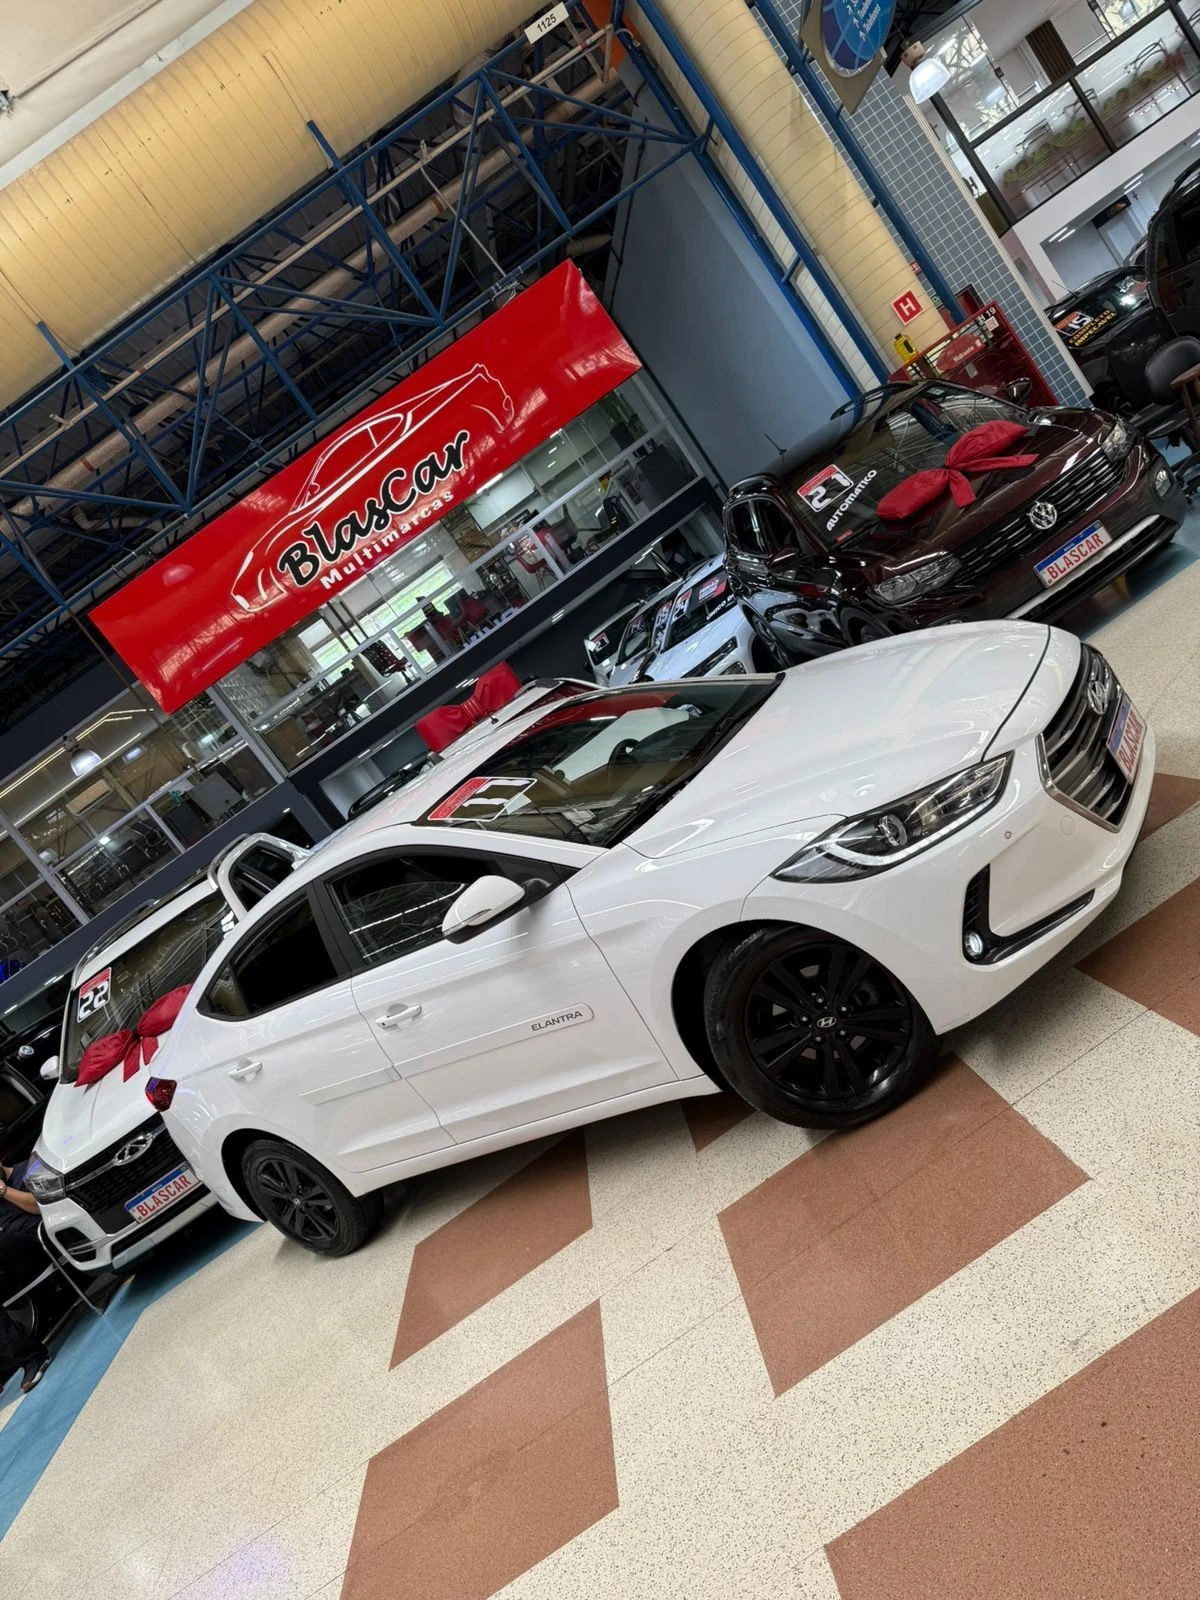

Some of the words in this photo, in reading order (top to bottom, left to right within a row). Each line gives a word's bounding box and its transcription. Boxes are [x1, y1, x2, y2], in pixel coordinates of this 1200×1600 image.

[536, 12, 557, 33] 1125
[900, 297, 917, 317] H
[985, 306, 996, 317] 19
[1069, 310, 1111, 344] COMPLETO
[278, 429, 470, 587] BlasCar
[807, 473, 851, 509] 21
[319, 490, 455, 590] Multimarcas
[1046, 533, 1104, 580] BLASCAR
[1118, 710, 1143, 774] BLASCAR
[79, 980, 109, 1019] 22
[530, 1010, 583, 1032] ELANTRA
[136, 1175, 191, 1217] BLASCAR
